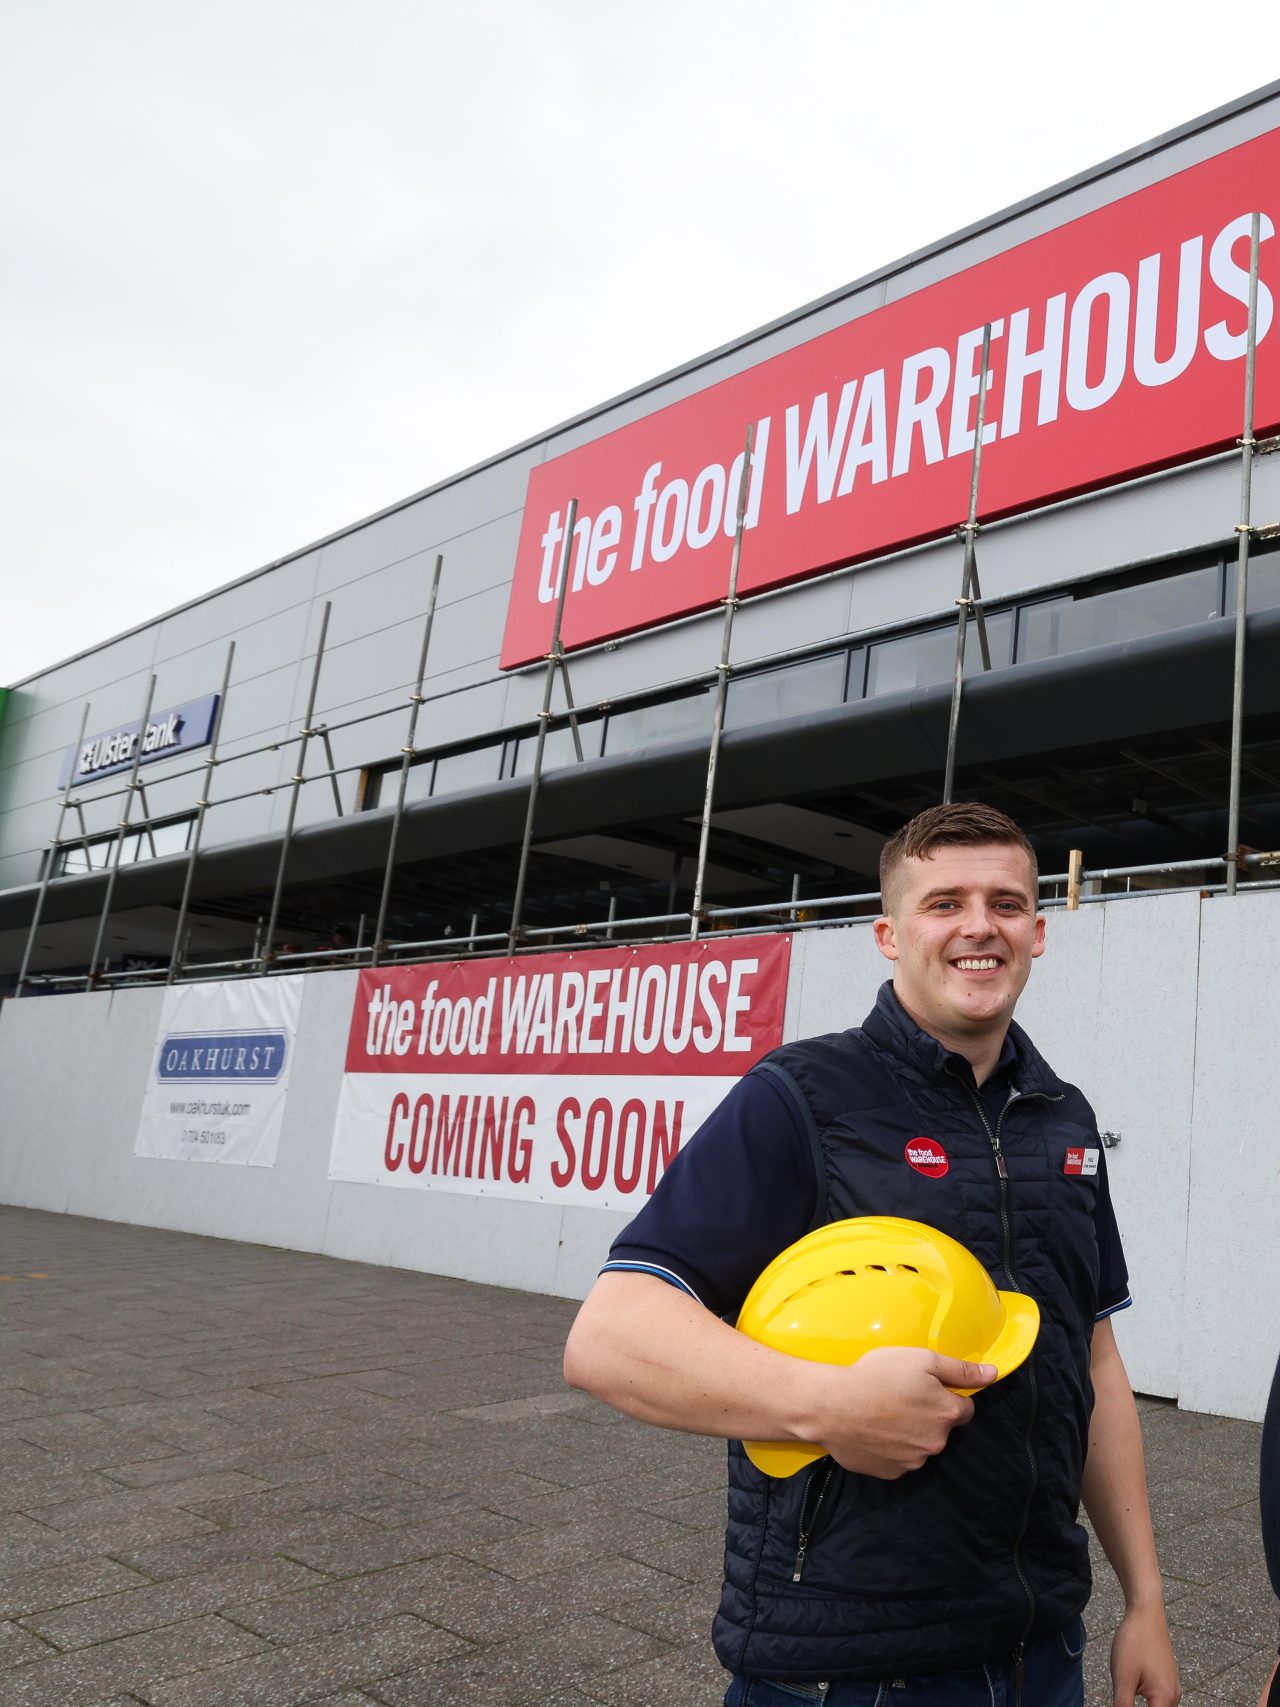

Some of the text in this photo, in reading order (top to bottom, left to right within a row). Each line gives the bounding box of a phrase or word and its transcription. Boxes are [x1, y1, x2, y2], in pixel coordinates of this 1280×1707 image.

[537, 499, 623, 604] the
[630, 415, 772, 572] food
[91, 733, 138, 770] Ulster
[365, 958, 760, 1056] the food WAREHOUSE
[165, 1046, 276, 1072] OAKHURST
[384, 1091, 685, 1196] COMING SOON
